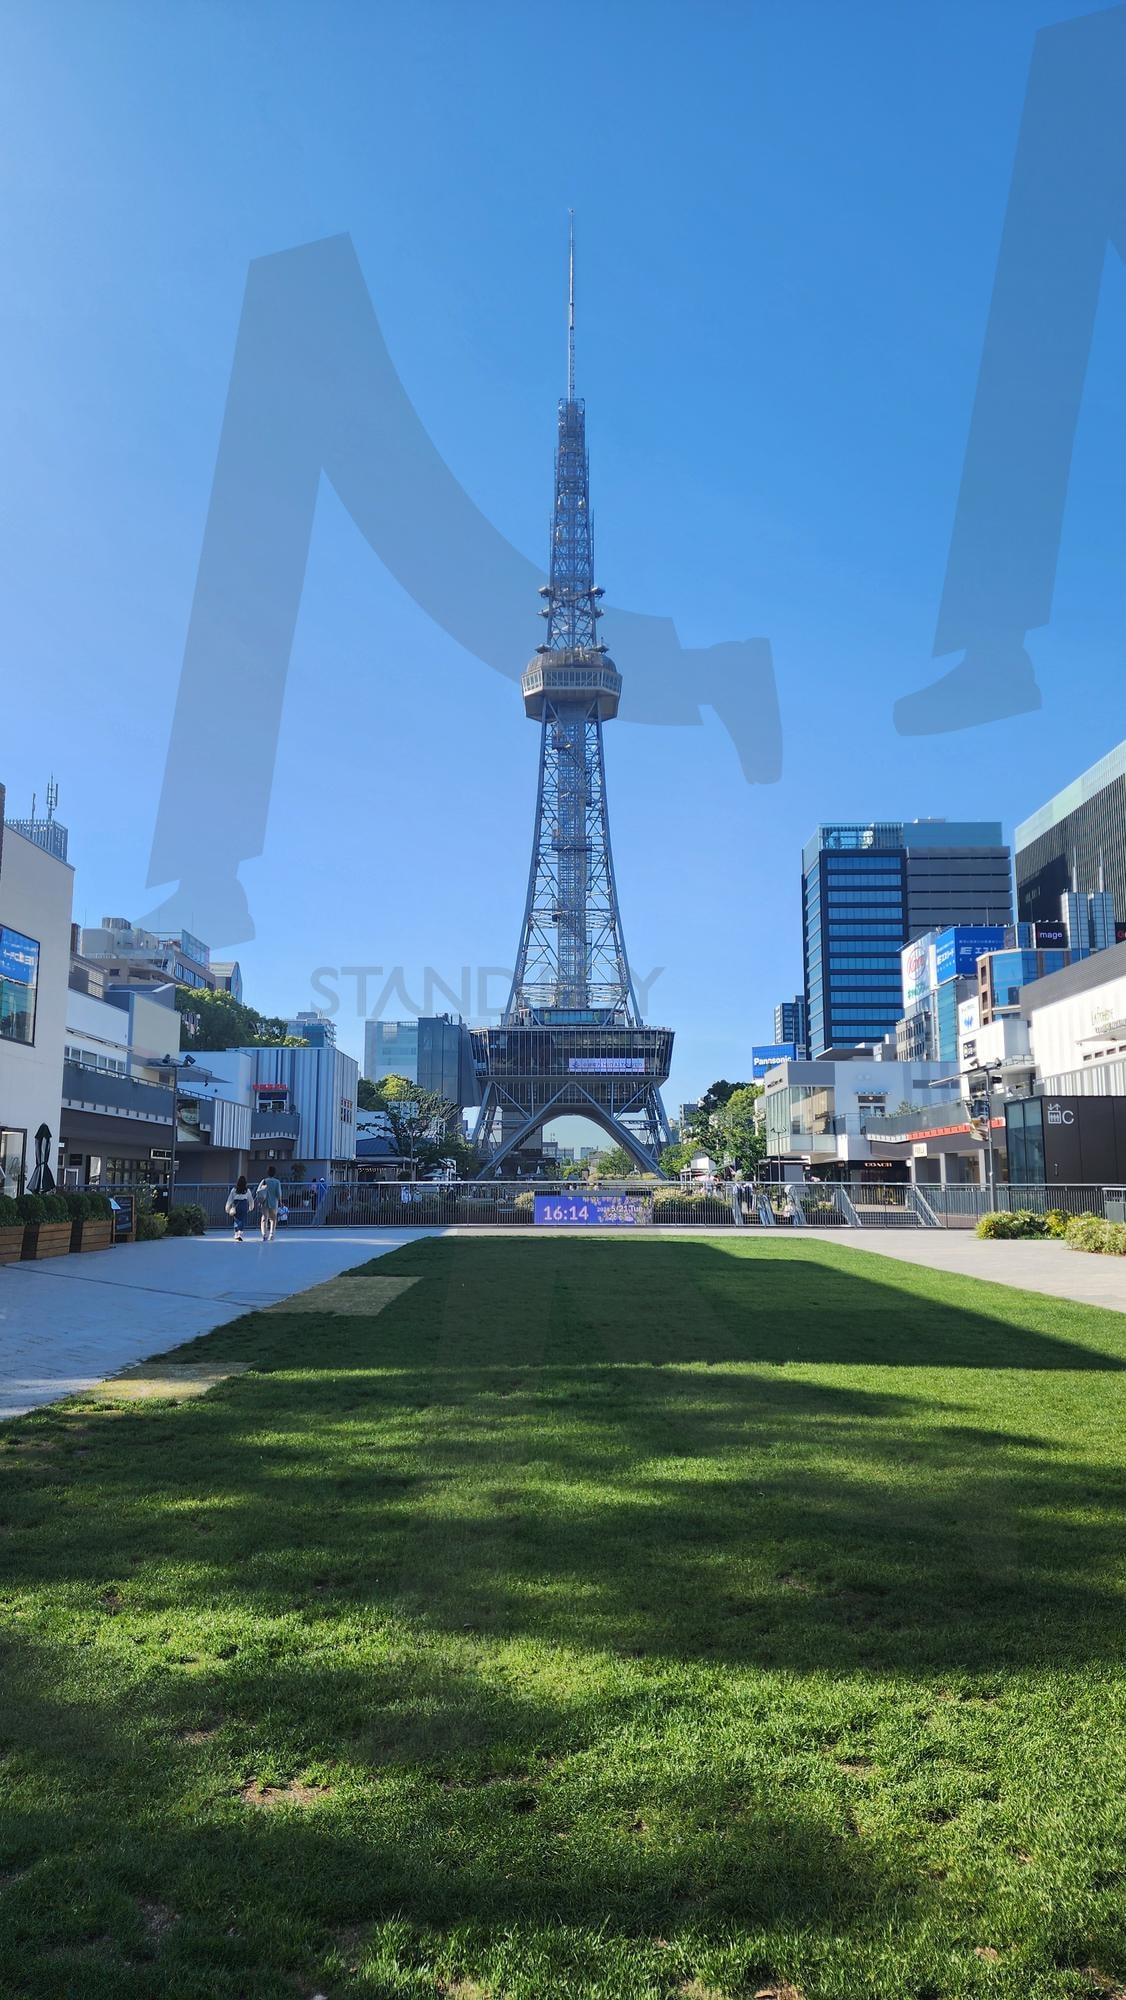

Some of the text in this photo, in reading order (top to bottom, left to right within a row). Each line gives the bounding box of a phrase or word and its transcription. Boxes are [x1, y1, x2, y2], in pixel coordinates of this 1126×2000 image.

[754, 1056, 792, 1065] Panasonic
[1062, 1110, 1074, 1124] C
[543, 1206, 589, 1220] 16:14
